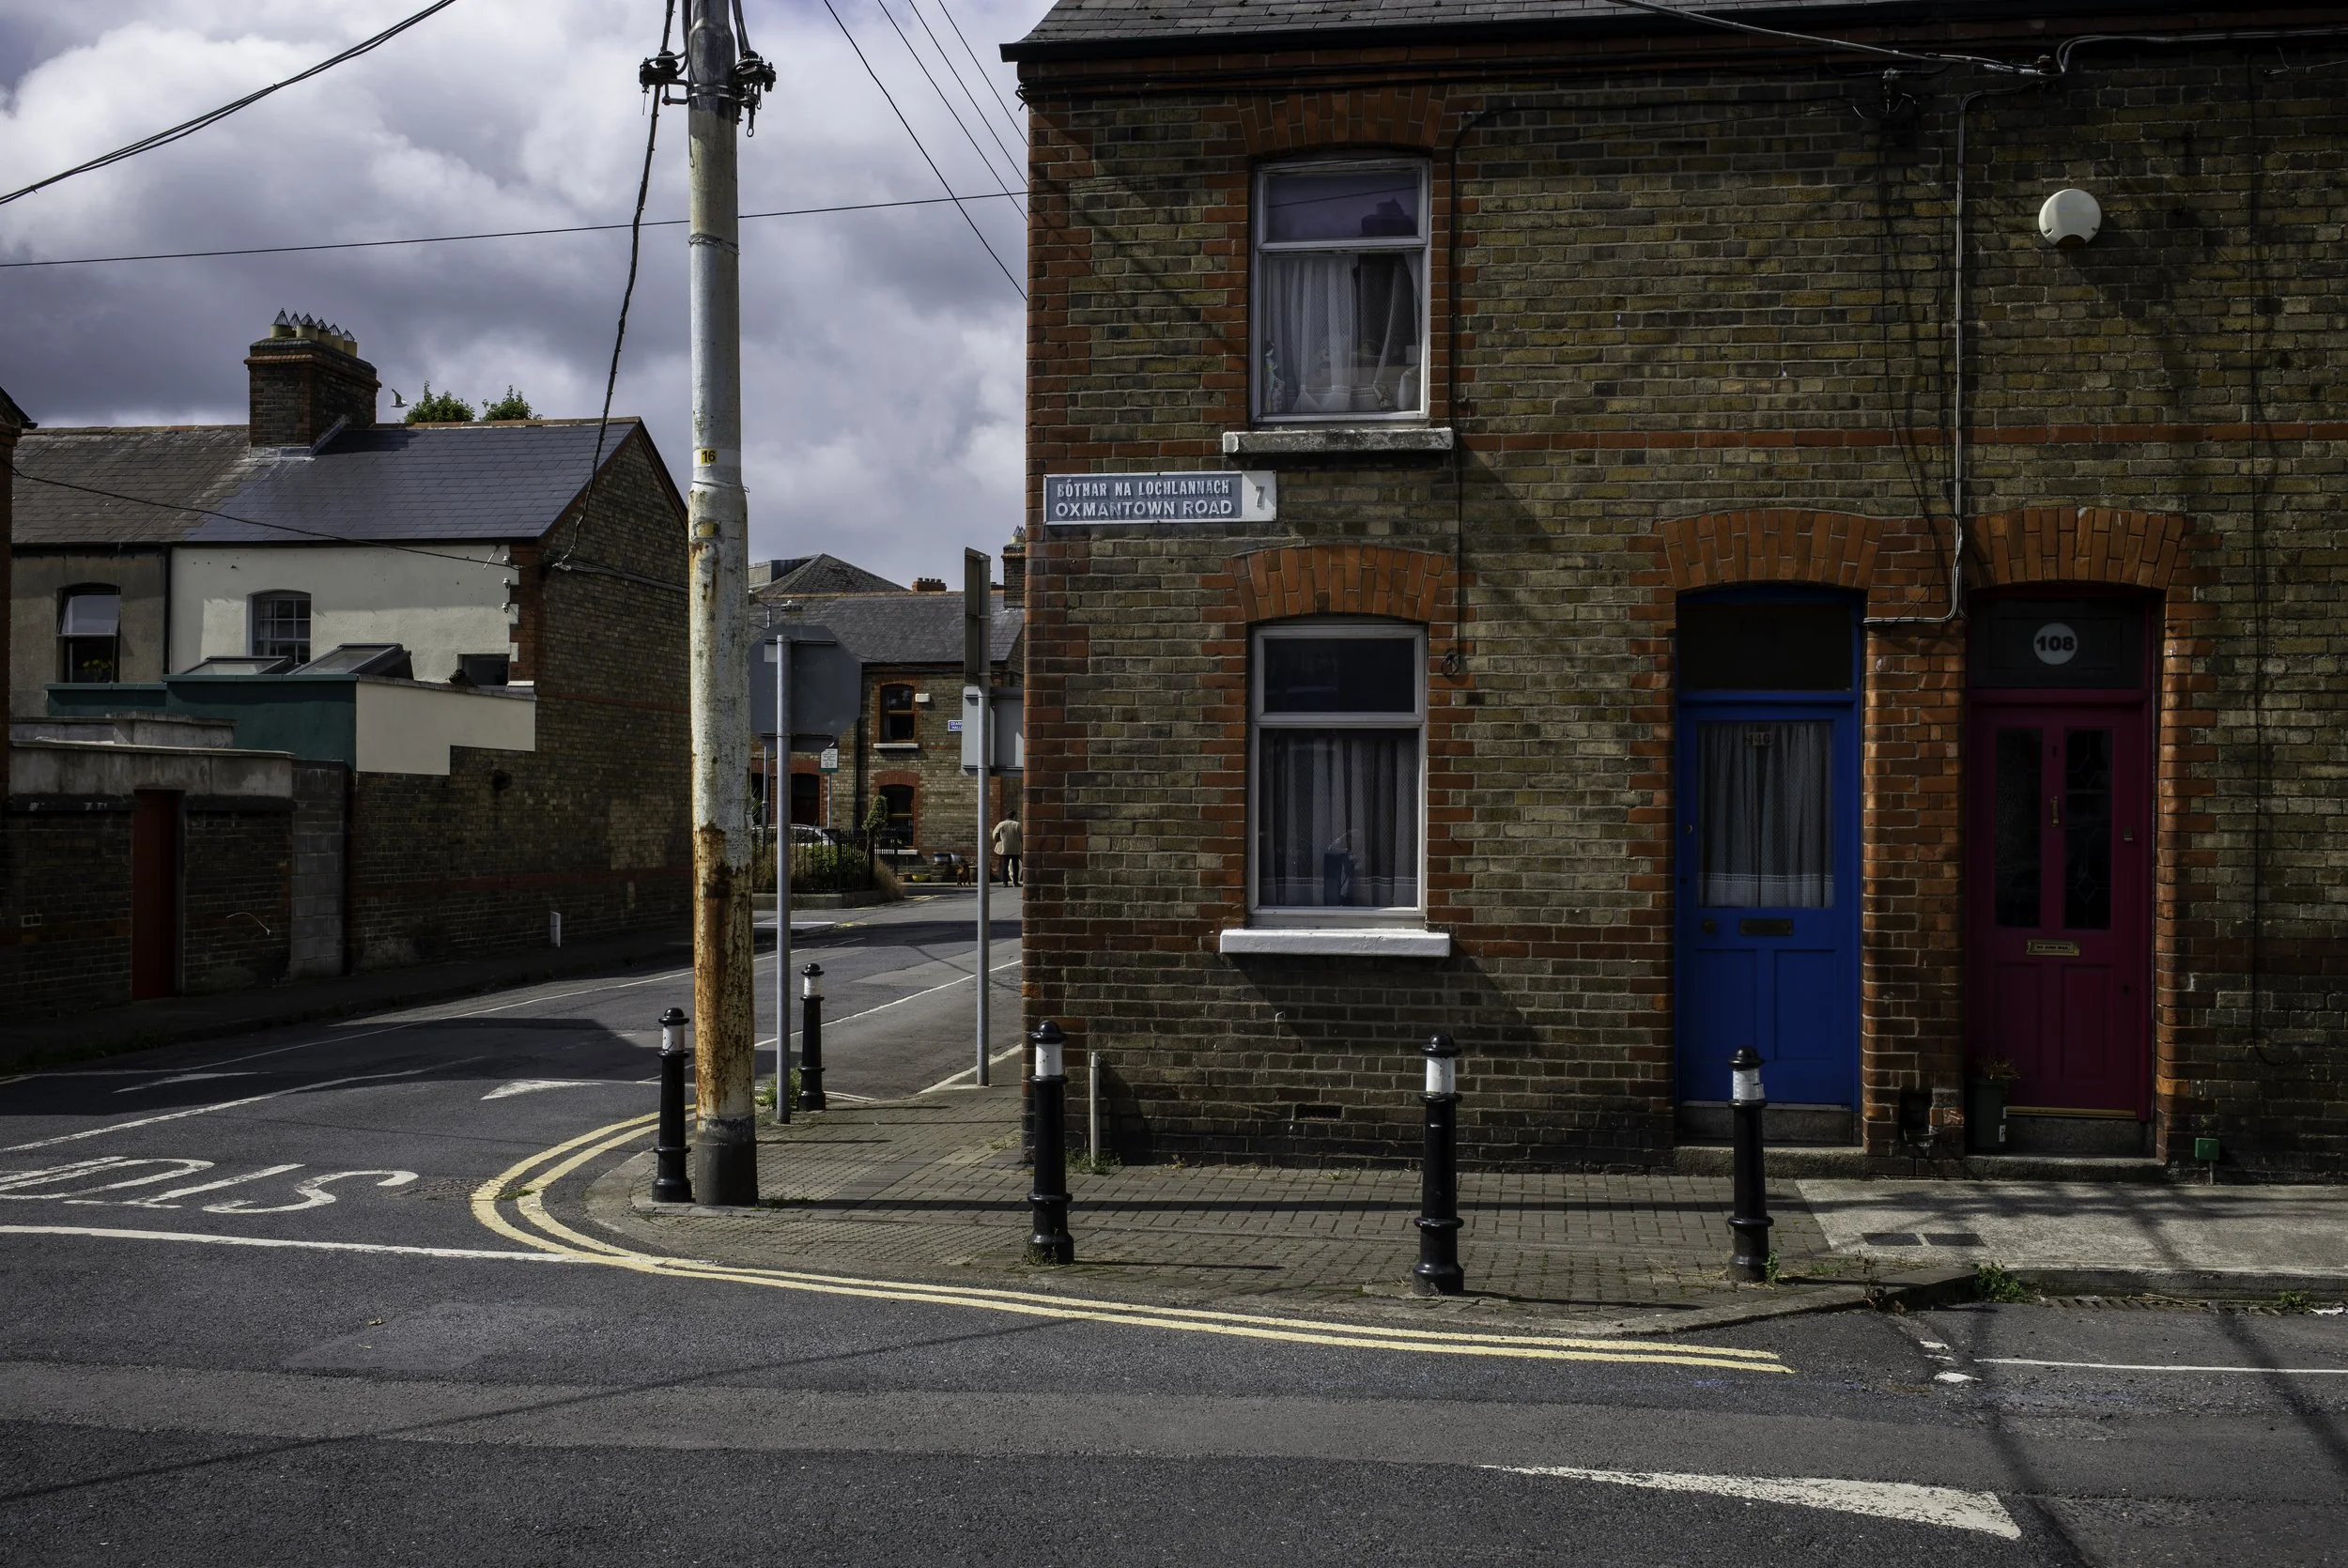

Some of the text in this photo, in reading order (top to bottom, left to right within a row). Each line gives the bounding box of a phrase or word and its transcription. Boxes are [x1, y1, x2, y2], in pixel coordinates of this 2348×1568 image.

[702, 450, 716, 463] 16
[1057, 479, 1229, 498] BÓTHAR NA LOCHLANNACH
[1255, 485, 1265, 508] 7
[1055, 500, 1232, 517] OXMANTOWN ROAD
[2036, 636, 2075, 652] 108
